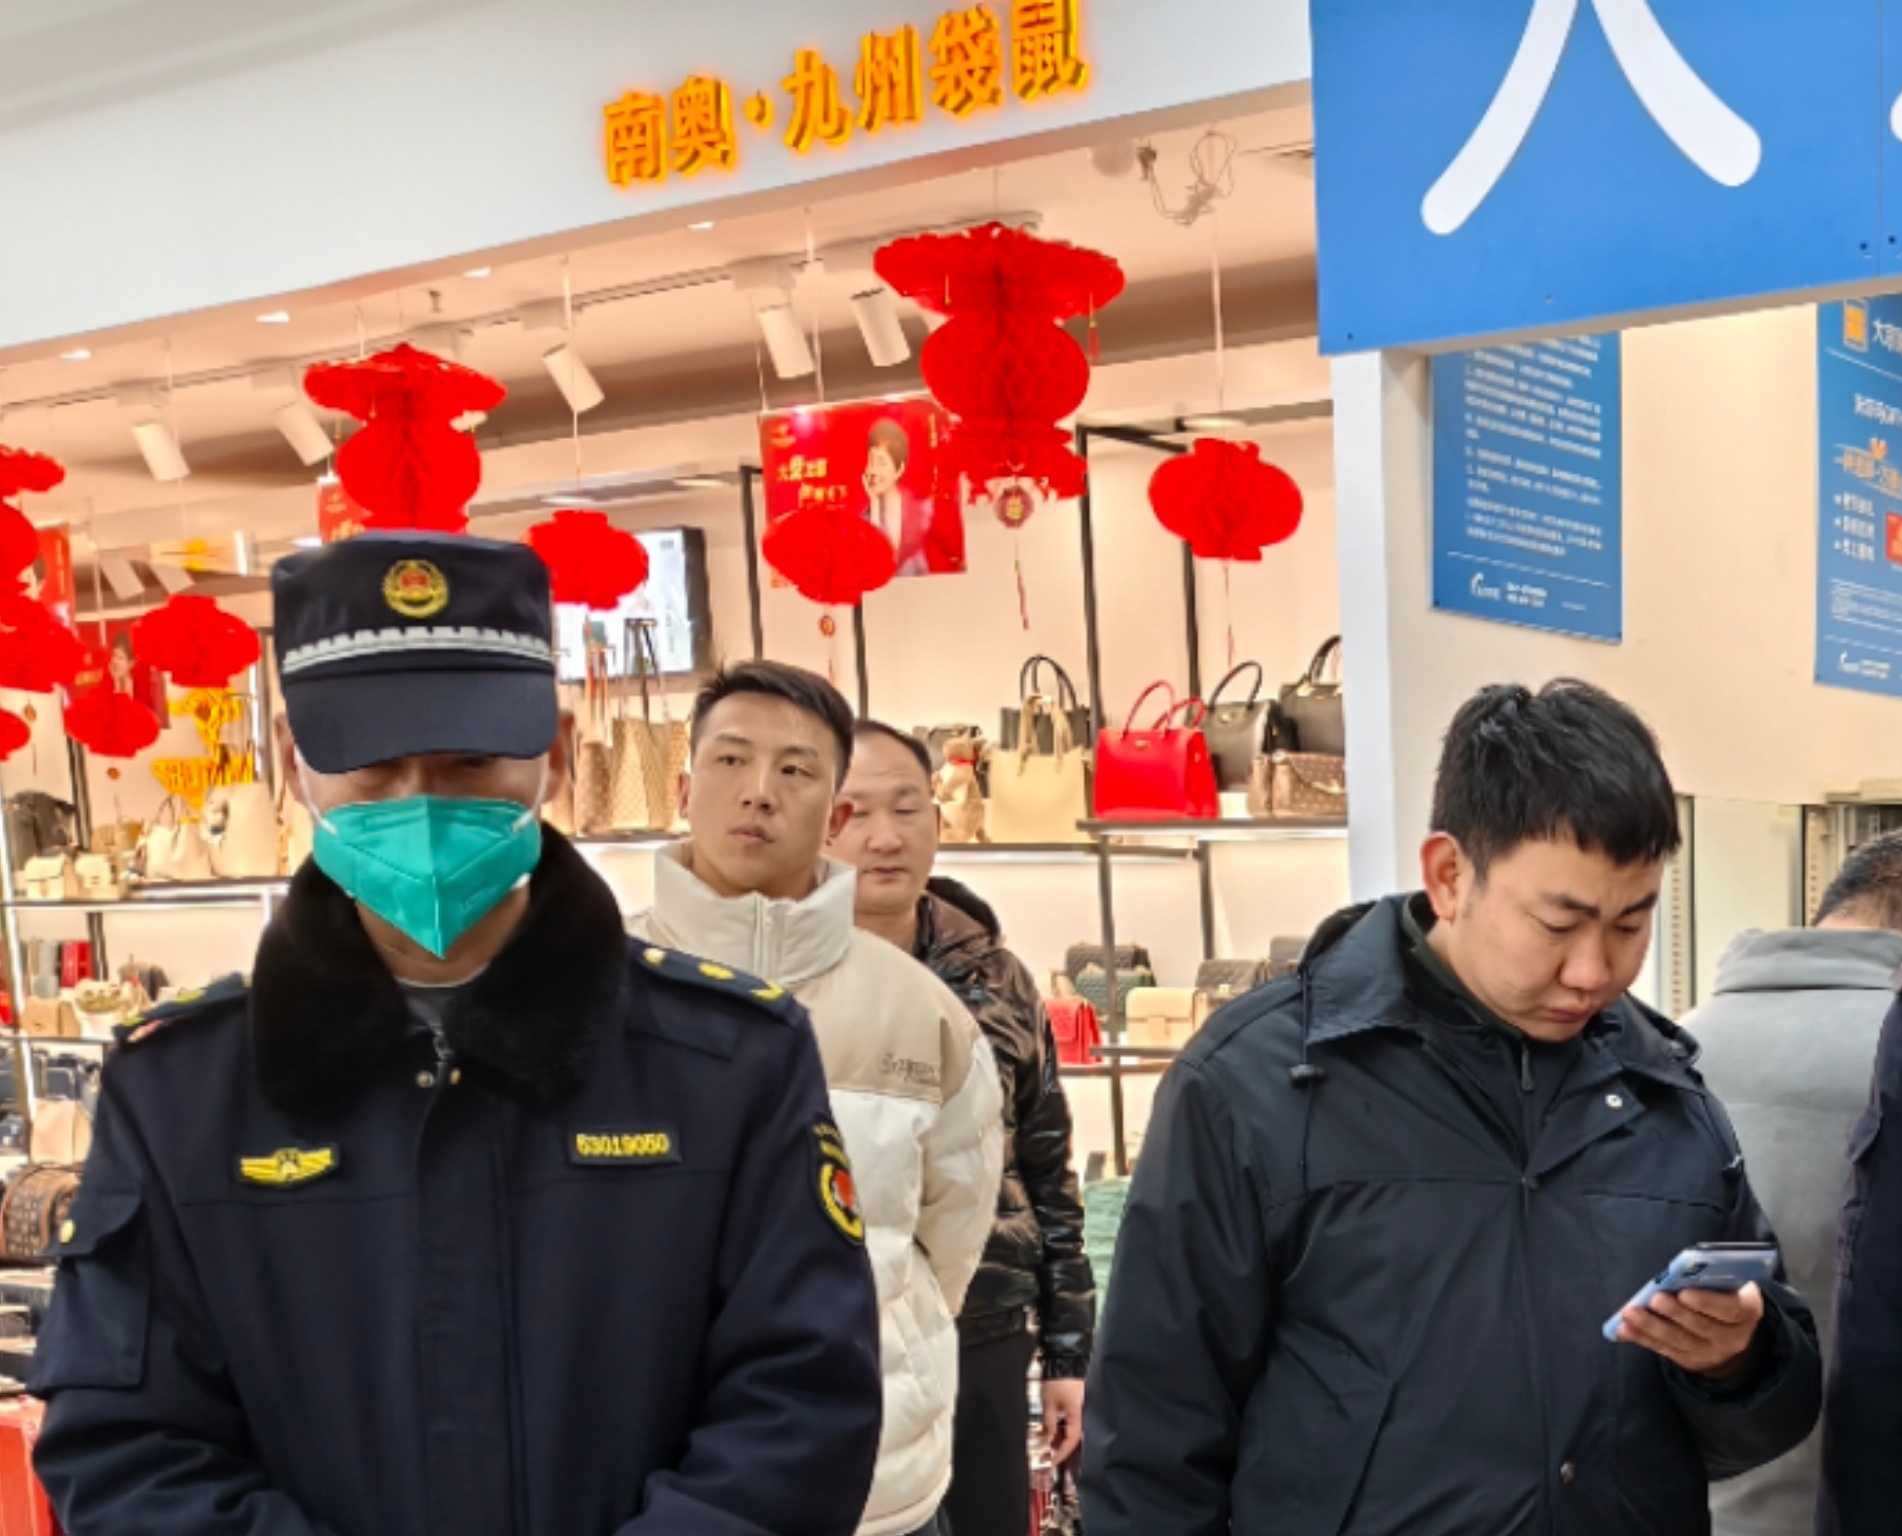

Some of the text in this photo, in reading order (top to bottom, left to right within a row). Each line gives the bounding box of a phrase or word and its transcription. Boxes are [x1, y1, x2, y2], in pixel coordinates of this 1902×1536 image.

[603, 0, 1090, 187] 南奥·九州袋鼠
